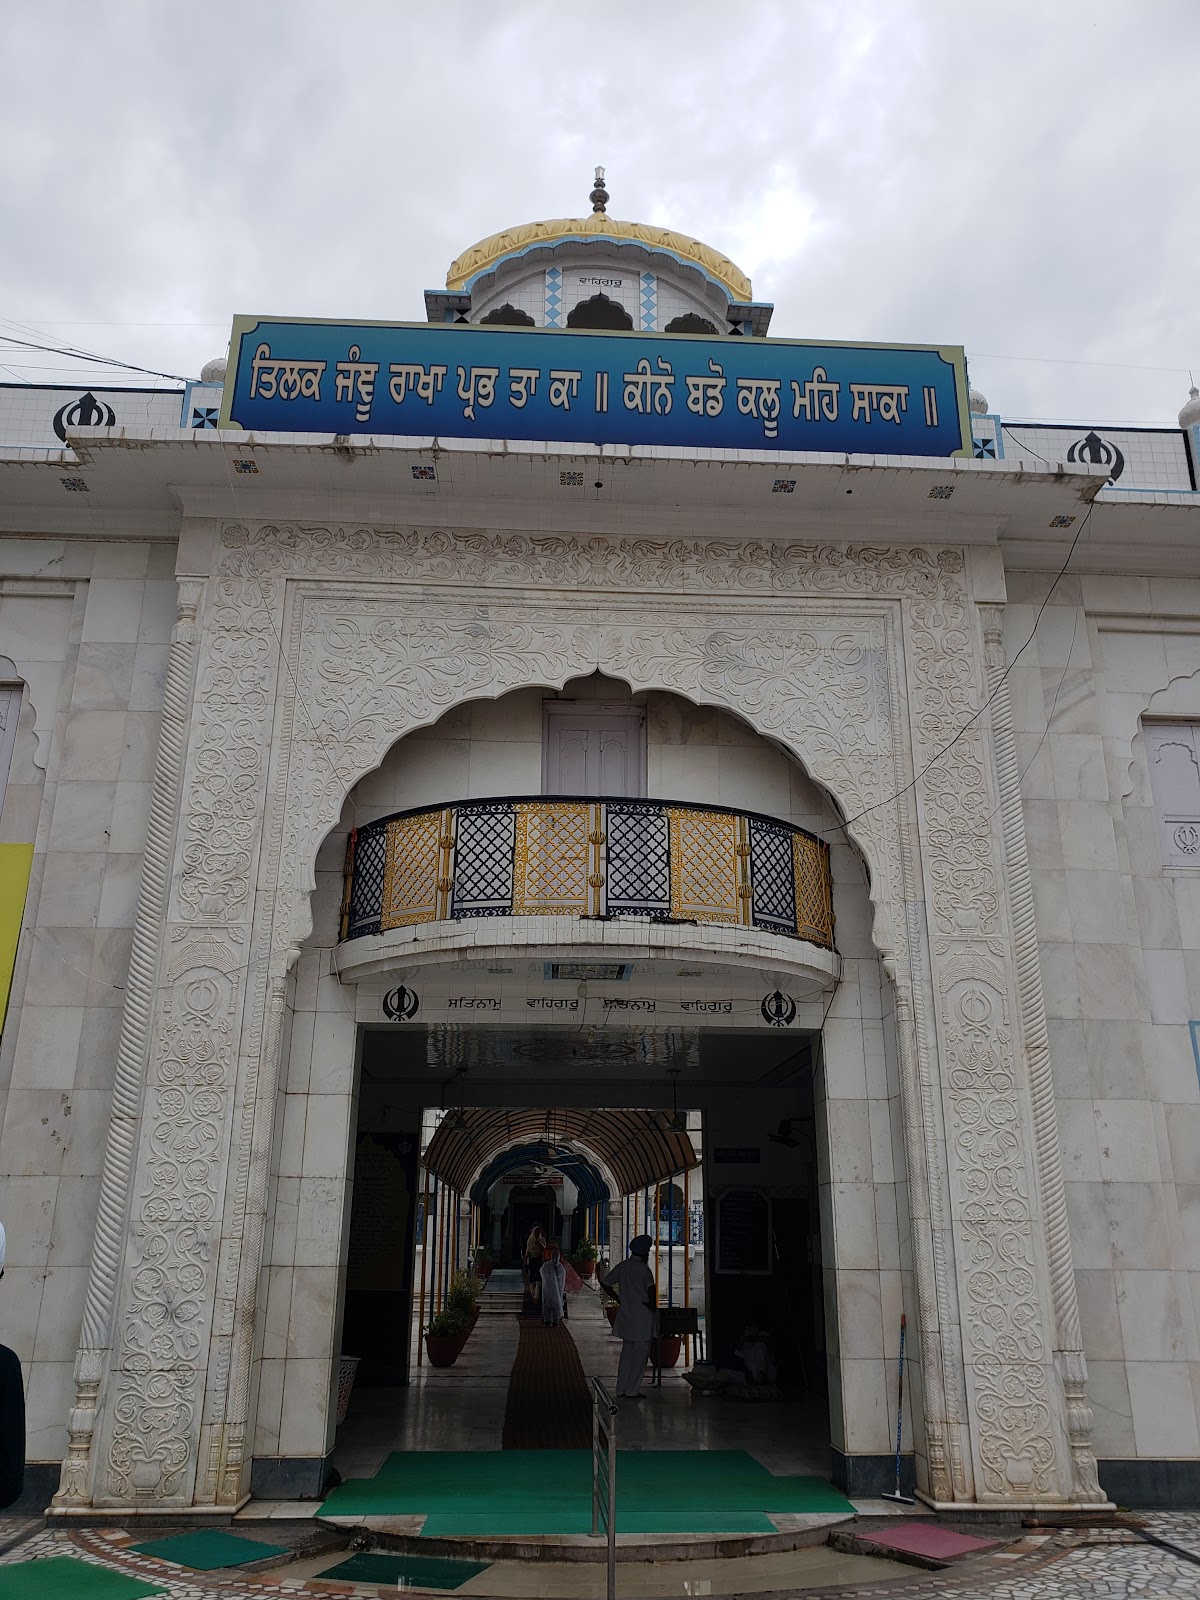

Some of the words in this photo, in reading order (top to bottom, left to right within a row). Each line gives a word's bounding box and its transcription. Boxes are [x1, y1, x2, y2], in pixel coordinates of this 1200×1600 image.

[250, 343, 327, 401] ਤਿਲਕ
[334, 344, 380, 422] ਜੰਞੂ
[388, 363, 447, 405] ਰਾਖਾ
[456, 365, 499, 421] ਪ੍ਰਭ
[508, 367, 540, 410] ਤਾ
[549, 368, 582, 412] ਕਾ
[622, 355, 675, 416] ਕੀਨੋ
[685, 357, 727, 418] ਬਡੋ
[736, 377, 781, 438] ਕਲੂ
[790, 365, 840, 422] ਮਹਿ
[849, 382, 910, 425] ਸਾਕਾ
[448, 996, 502, 1011] ਸਤਿਨਾਮੁ
[526, 996, 579, 1012] ਵਾਹਿਗੁਰੂ
